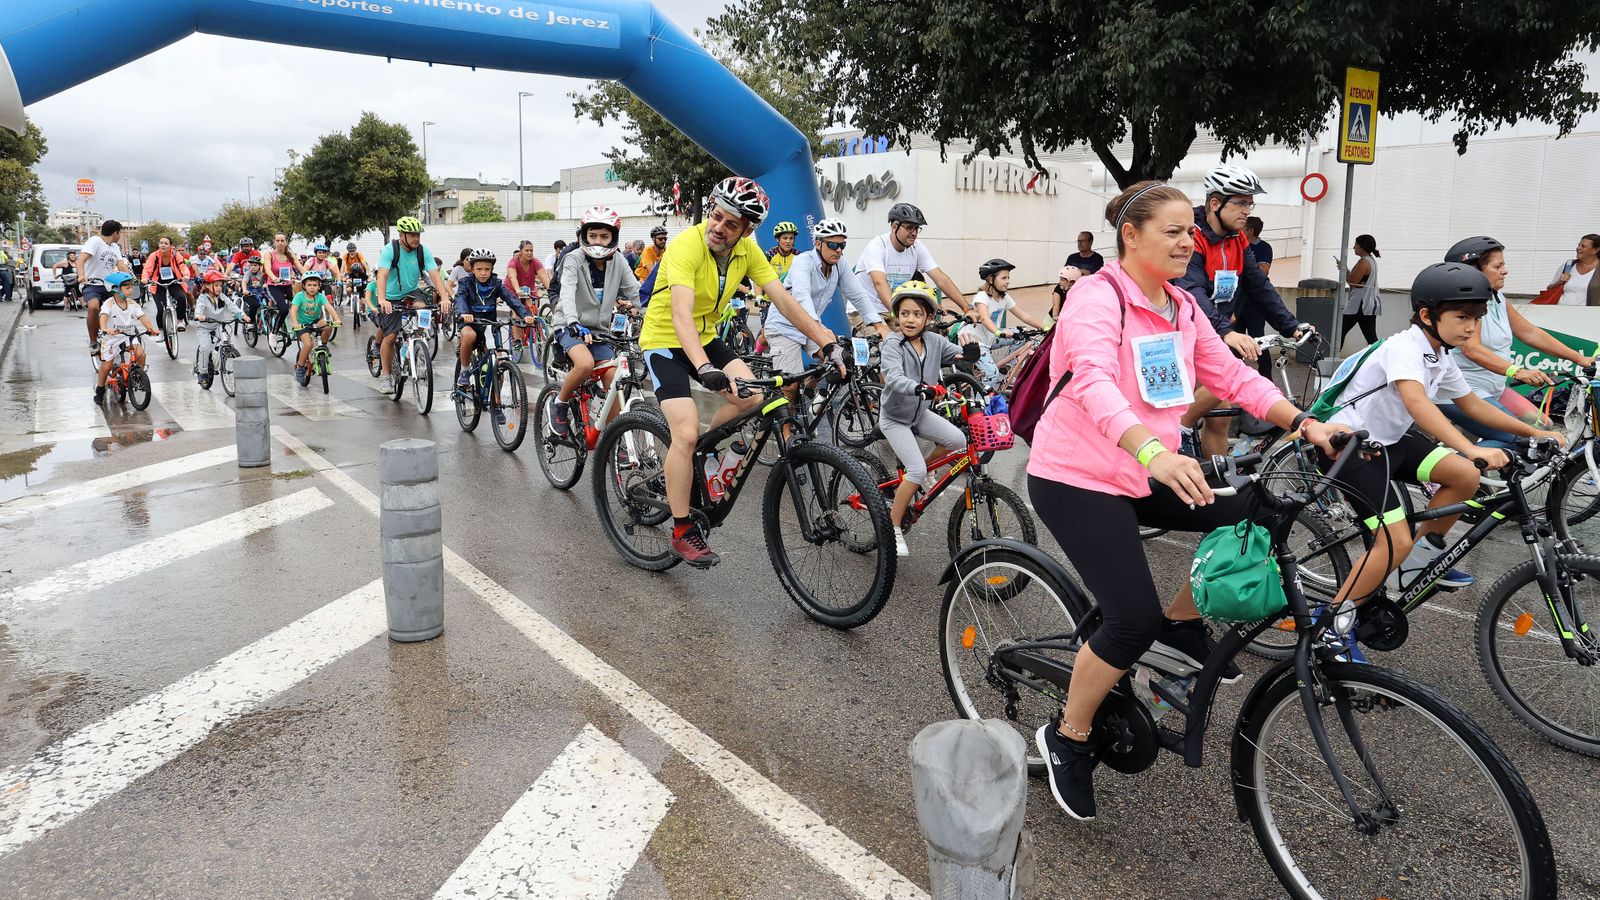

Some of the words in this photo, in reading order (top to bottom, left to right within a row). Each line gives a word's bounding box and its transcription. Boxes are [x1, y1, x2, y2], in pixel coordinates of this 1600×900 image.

[297, 0, 394, 15] portes
[508, 6, 539, 20] de
[546, 10, 610, 30] Jerez
[1349, 87, 1374, 101] ATENCIÓN
[1344, 145, 1371, 159] PEATONES
[1404, 539, 1471, 603] ROCKRIDER
